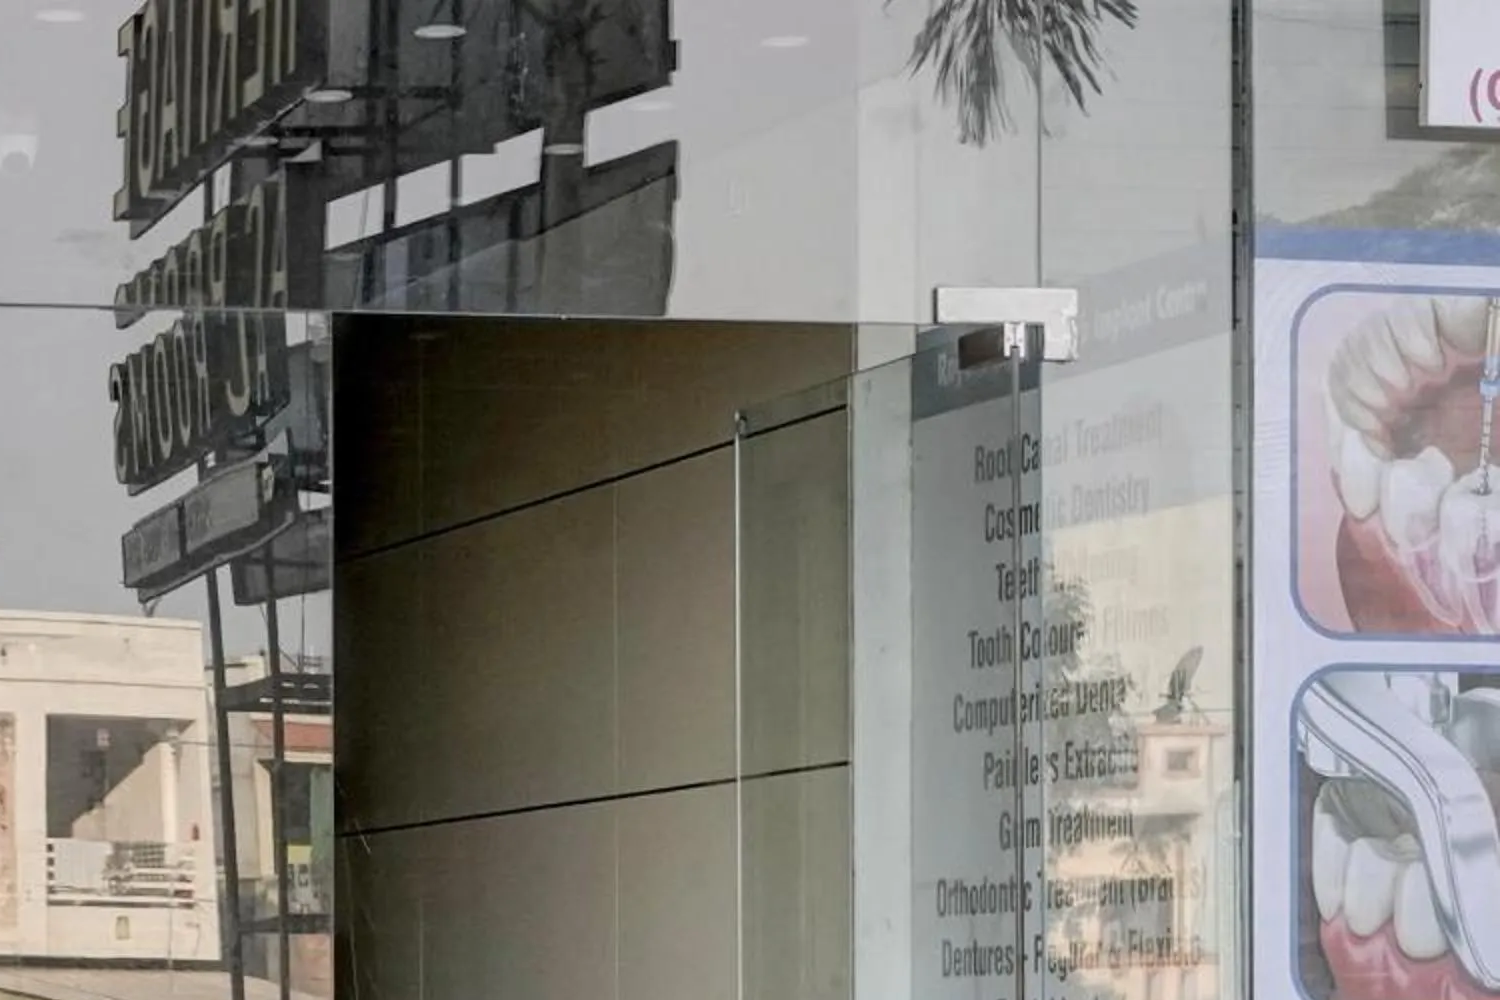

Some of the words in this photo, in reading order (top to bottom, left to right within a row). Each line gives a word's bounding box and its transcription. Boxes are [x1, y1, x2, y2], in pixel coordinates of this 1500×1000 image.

[999, 812, 1041, 851] Gm
[936, 872, 1033, 918] Orthodontc
[942, 937, 1014, 978] Dentures
